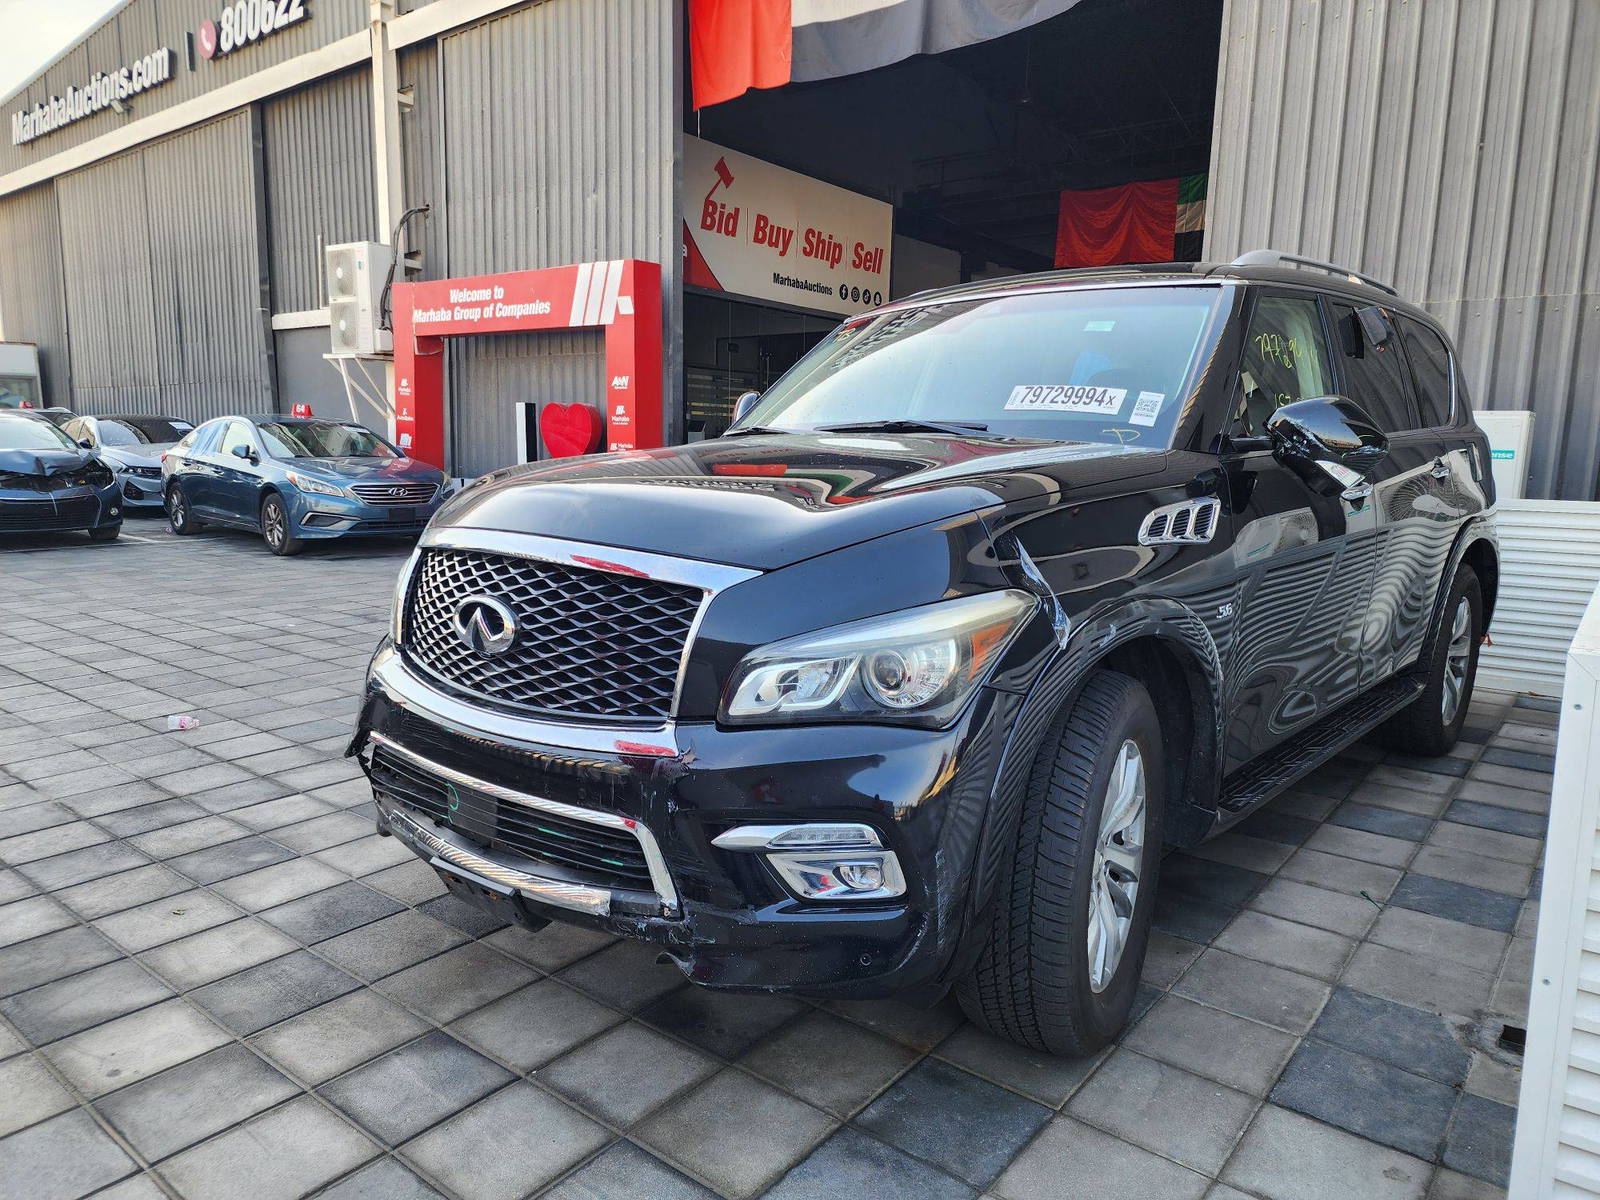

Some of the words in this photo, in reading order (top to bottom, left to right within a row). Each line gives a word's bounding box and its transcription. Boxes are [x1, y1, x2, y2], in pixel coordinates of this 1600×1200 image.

[12, 47, 171, 145] MarhabaAuctions.com
[701, 199, 740, 238] Bid
[753, 213, 794, 257] Buy
[802, 228, 843, 269] Ship
[852, 242, 884, 274] Sell
[450, 289, 491, 304] Welcome
[493, 286, 504, 300] to
[773, 272, 833, 296] MarhabaAuctions
[413, 308, 452, 323] Marhaba
[454, 306, 481, 322] Group
[483, 305, 494, 318] of
[495, 300, 551, 320] Companies
